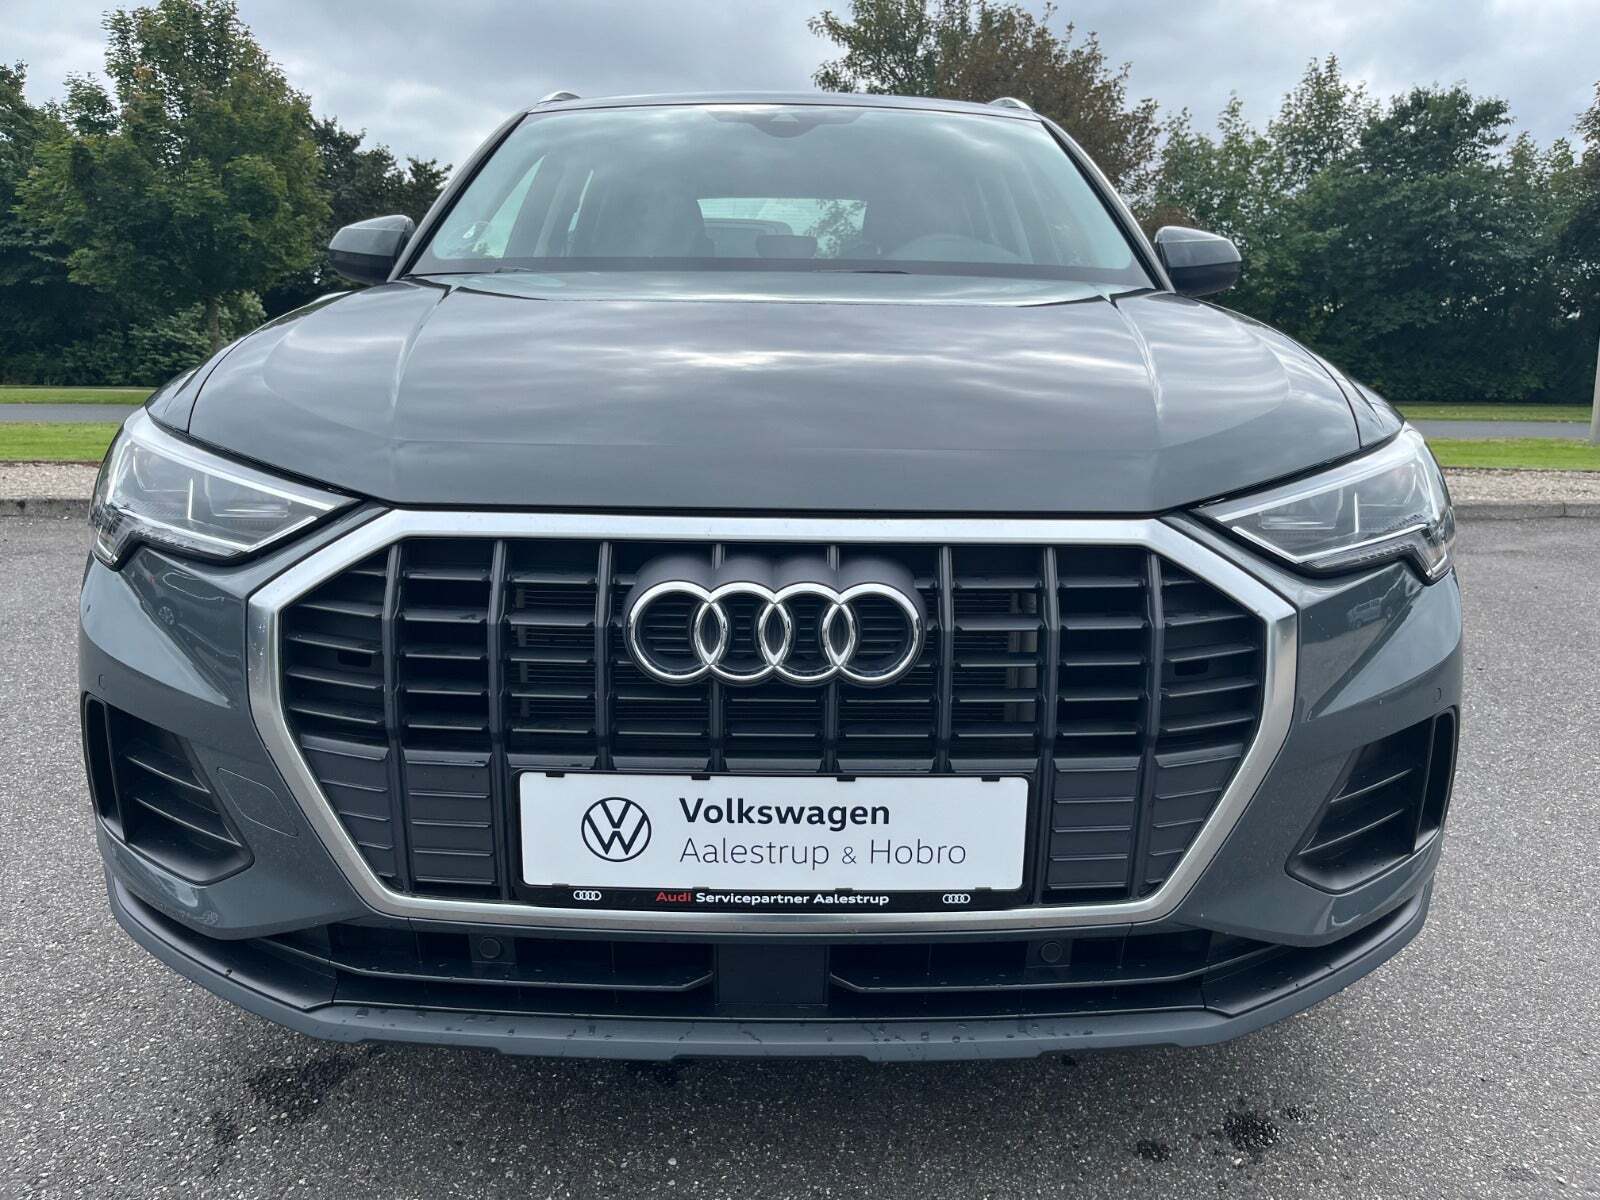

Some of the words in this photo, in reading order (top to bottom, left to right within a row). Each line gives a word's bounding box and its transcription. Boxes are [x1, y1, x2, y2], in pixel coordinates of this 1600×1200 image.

[679, 797, 890, 832] Volkswagen
[679, 837, 830, 871] Aalestrup
[841, 846, 857, 865] &
[870, 838, 967, 865] Hobro
[655, 891, 692, 903] Audi
[695, 892, 810, 906] Servicepartner
[813, 893, 890, 906] Aalestrup
